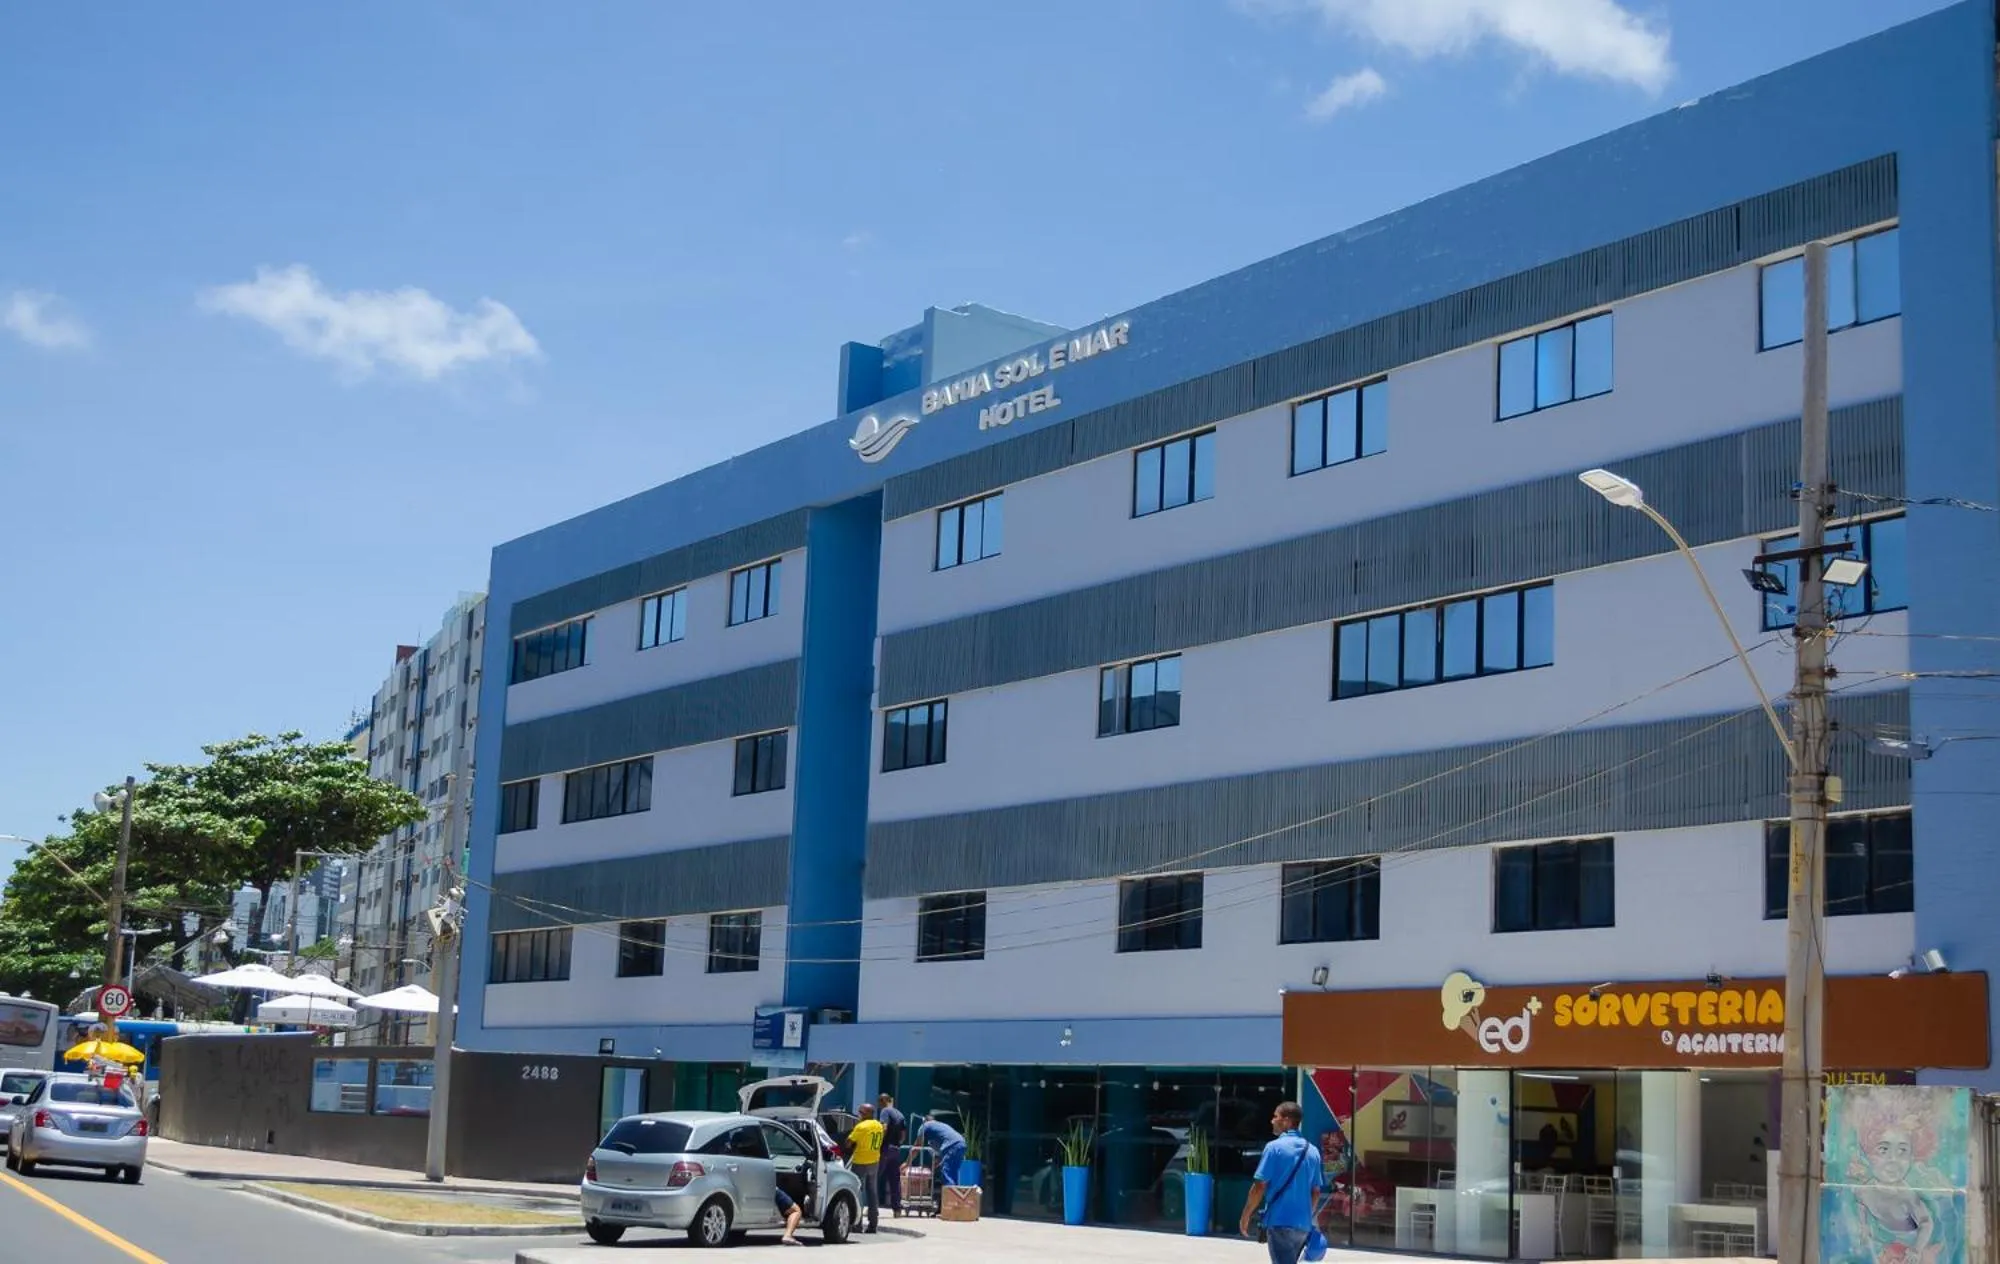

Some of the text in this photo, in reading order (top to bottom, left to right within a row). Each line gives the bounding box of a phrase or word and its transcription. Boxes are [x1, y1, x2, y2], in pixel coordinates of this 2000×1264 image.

[921, 321, 1130, 415] BAHIA SOL E MAR
[979, 384, 1061, 430] HOTEL
[105, 992, 125, 1006] 60
[1554, 988, 1784, 1027] SORVETERIA
